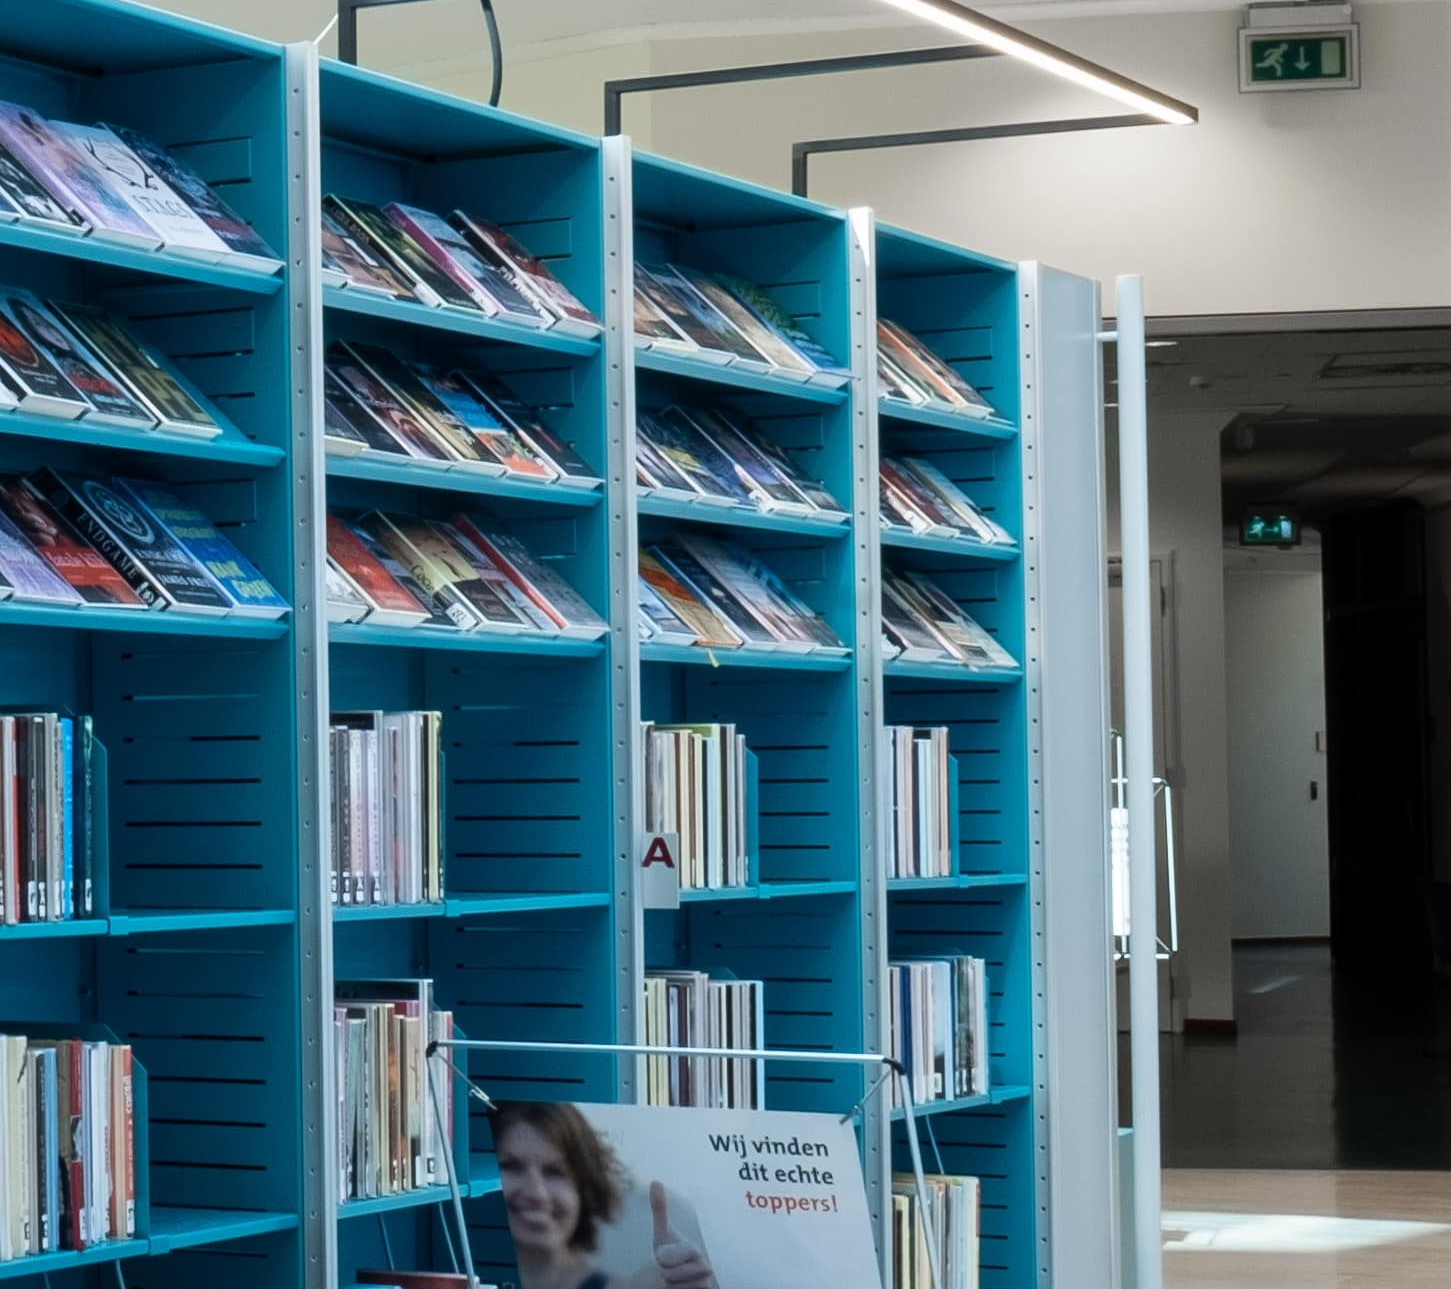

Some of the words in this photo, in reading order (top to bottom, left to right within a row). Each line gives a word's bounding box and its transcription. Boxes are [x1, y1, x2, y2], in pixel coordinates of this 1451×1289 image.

[77, 512, 138, 579] ENDGAME
[641, 836, 675, 869] A
[708, 1134, 747, 1158] Wij
[751, 1136, 829, 1157] vinden
[738, 1162, 769, 1182] dit
[775, 1165, 834, 1185] echte
[745, 1190, 838, 1215] toppers!
